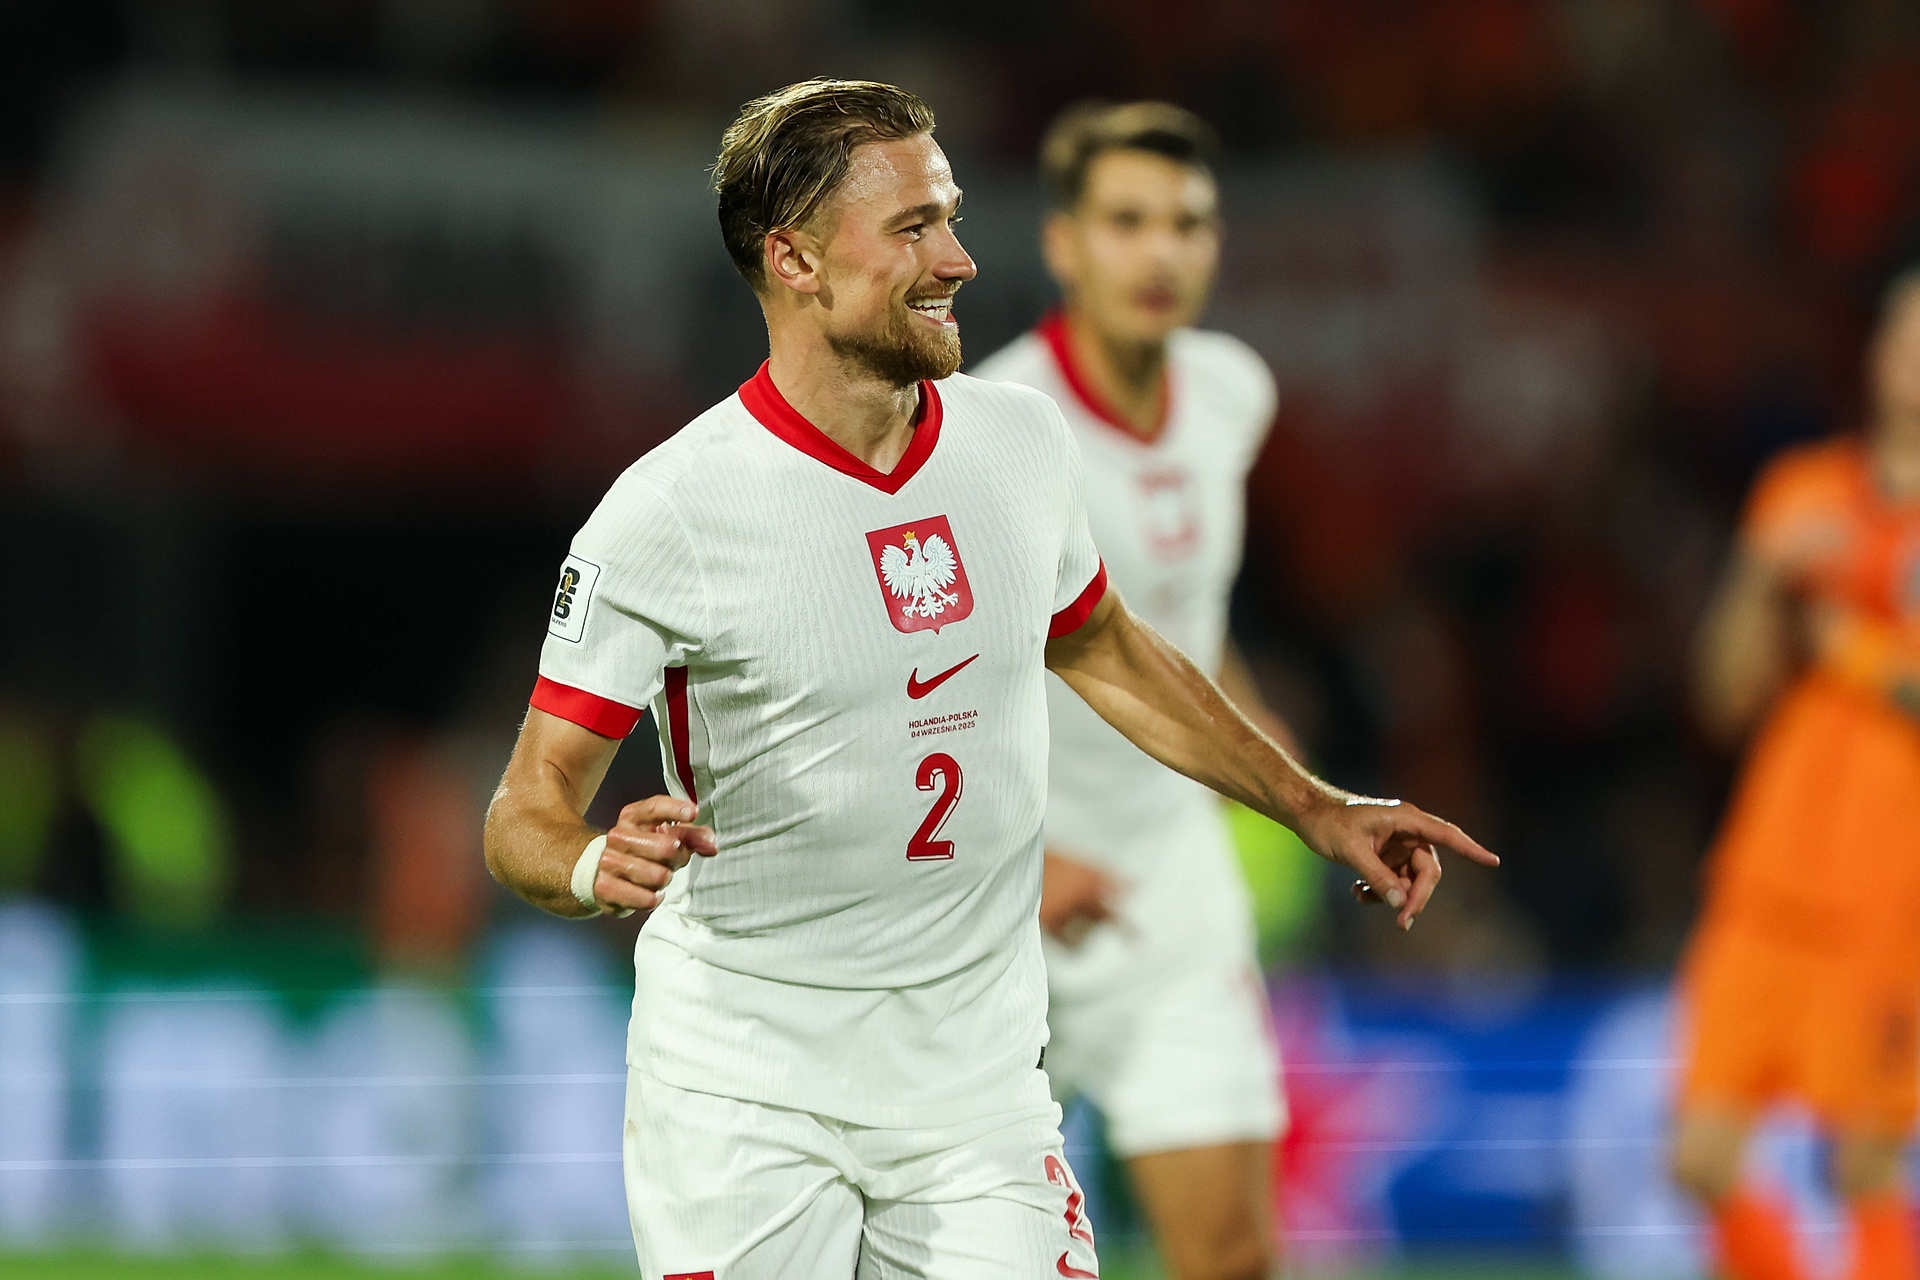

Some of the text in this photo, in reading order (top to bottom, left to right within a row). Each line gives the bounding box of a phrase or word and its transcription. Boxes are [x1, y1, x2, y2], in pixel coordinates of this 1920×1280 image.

[908, 709, 978, 729] HOLANDIA-POLSKA
[911, 720, 976, 738] 04 WRZEŚNIA 2025
[906, 752, 964, 862] 2
[1044, 1155, 1095, 1246] 2
